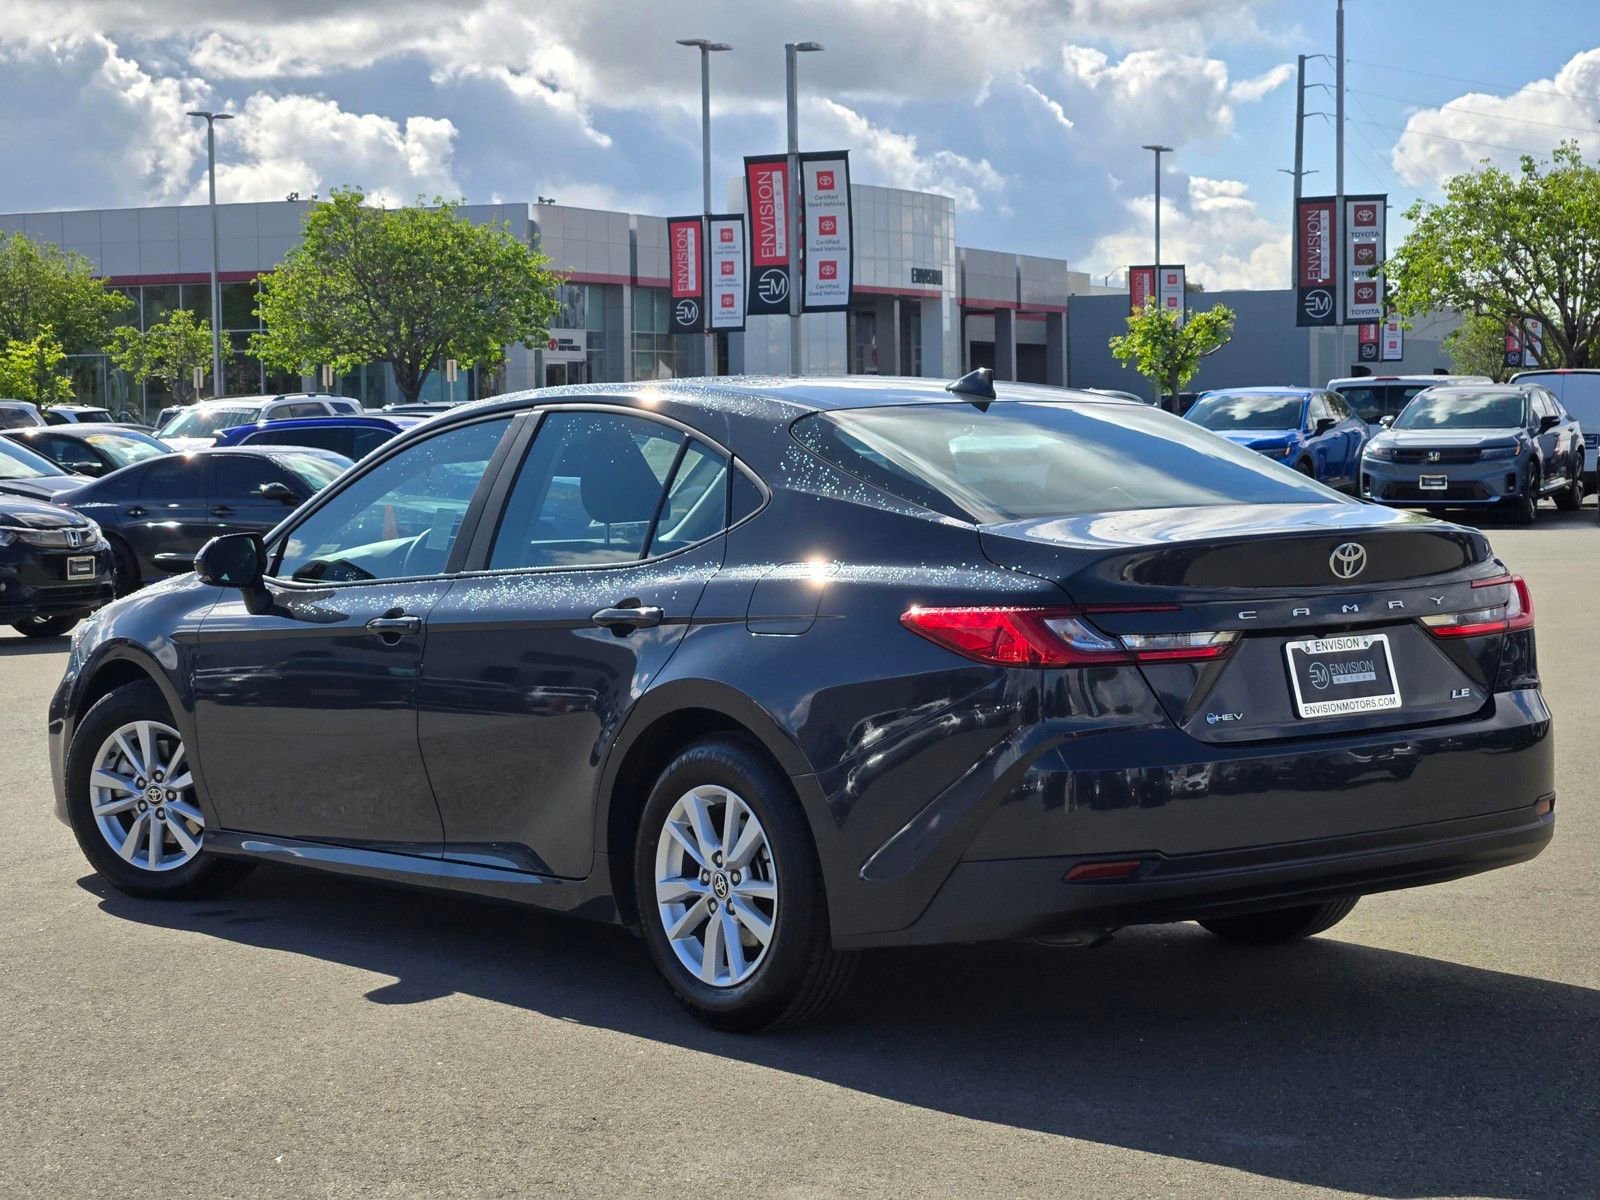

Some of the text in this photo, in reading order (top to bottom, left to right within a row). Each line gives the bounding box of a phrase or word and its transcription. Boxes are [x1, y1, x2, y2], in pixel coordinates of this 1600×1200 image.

[757, 171, 775, 258] ENVISION
[1307, 209, 1320, 280] ENVISION
[676, 227, 688, 291] ENVISION
[1238, 596, 1444, 619] CAMRY
[1315, 638, 1360, 651] ENVISION
[1329, 660, 1375, 675] ENVISION
[1452, 688, 1470, 699] LE
[1304, 697, 1397, 715] ENVISIONMOTORS.COM
